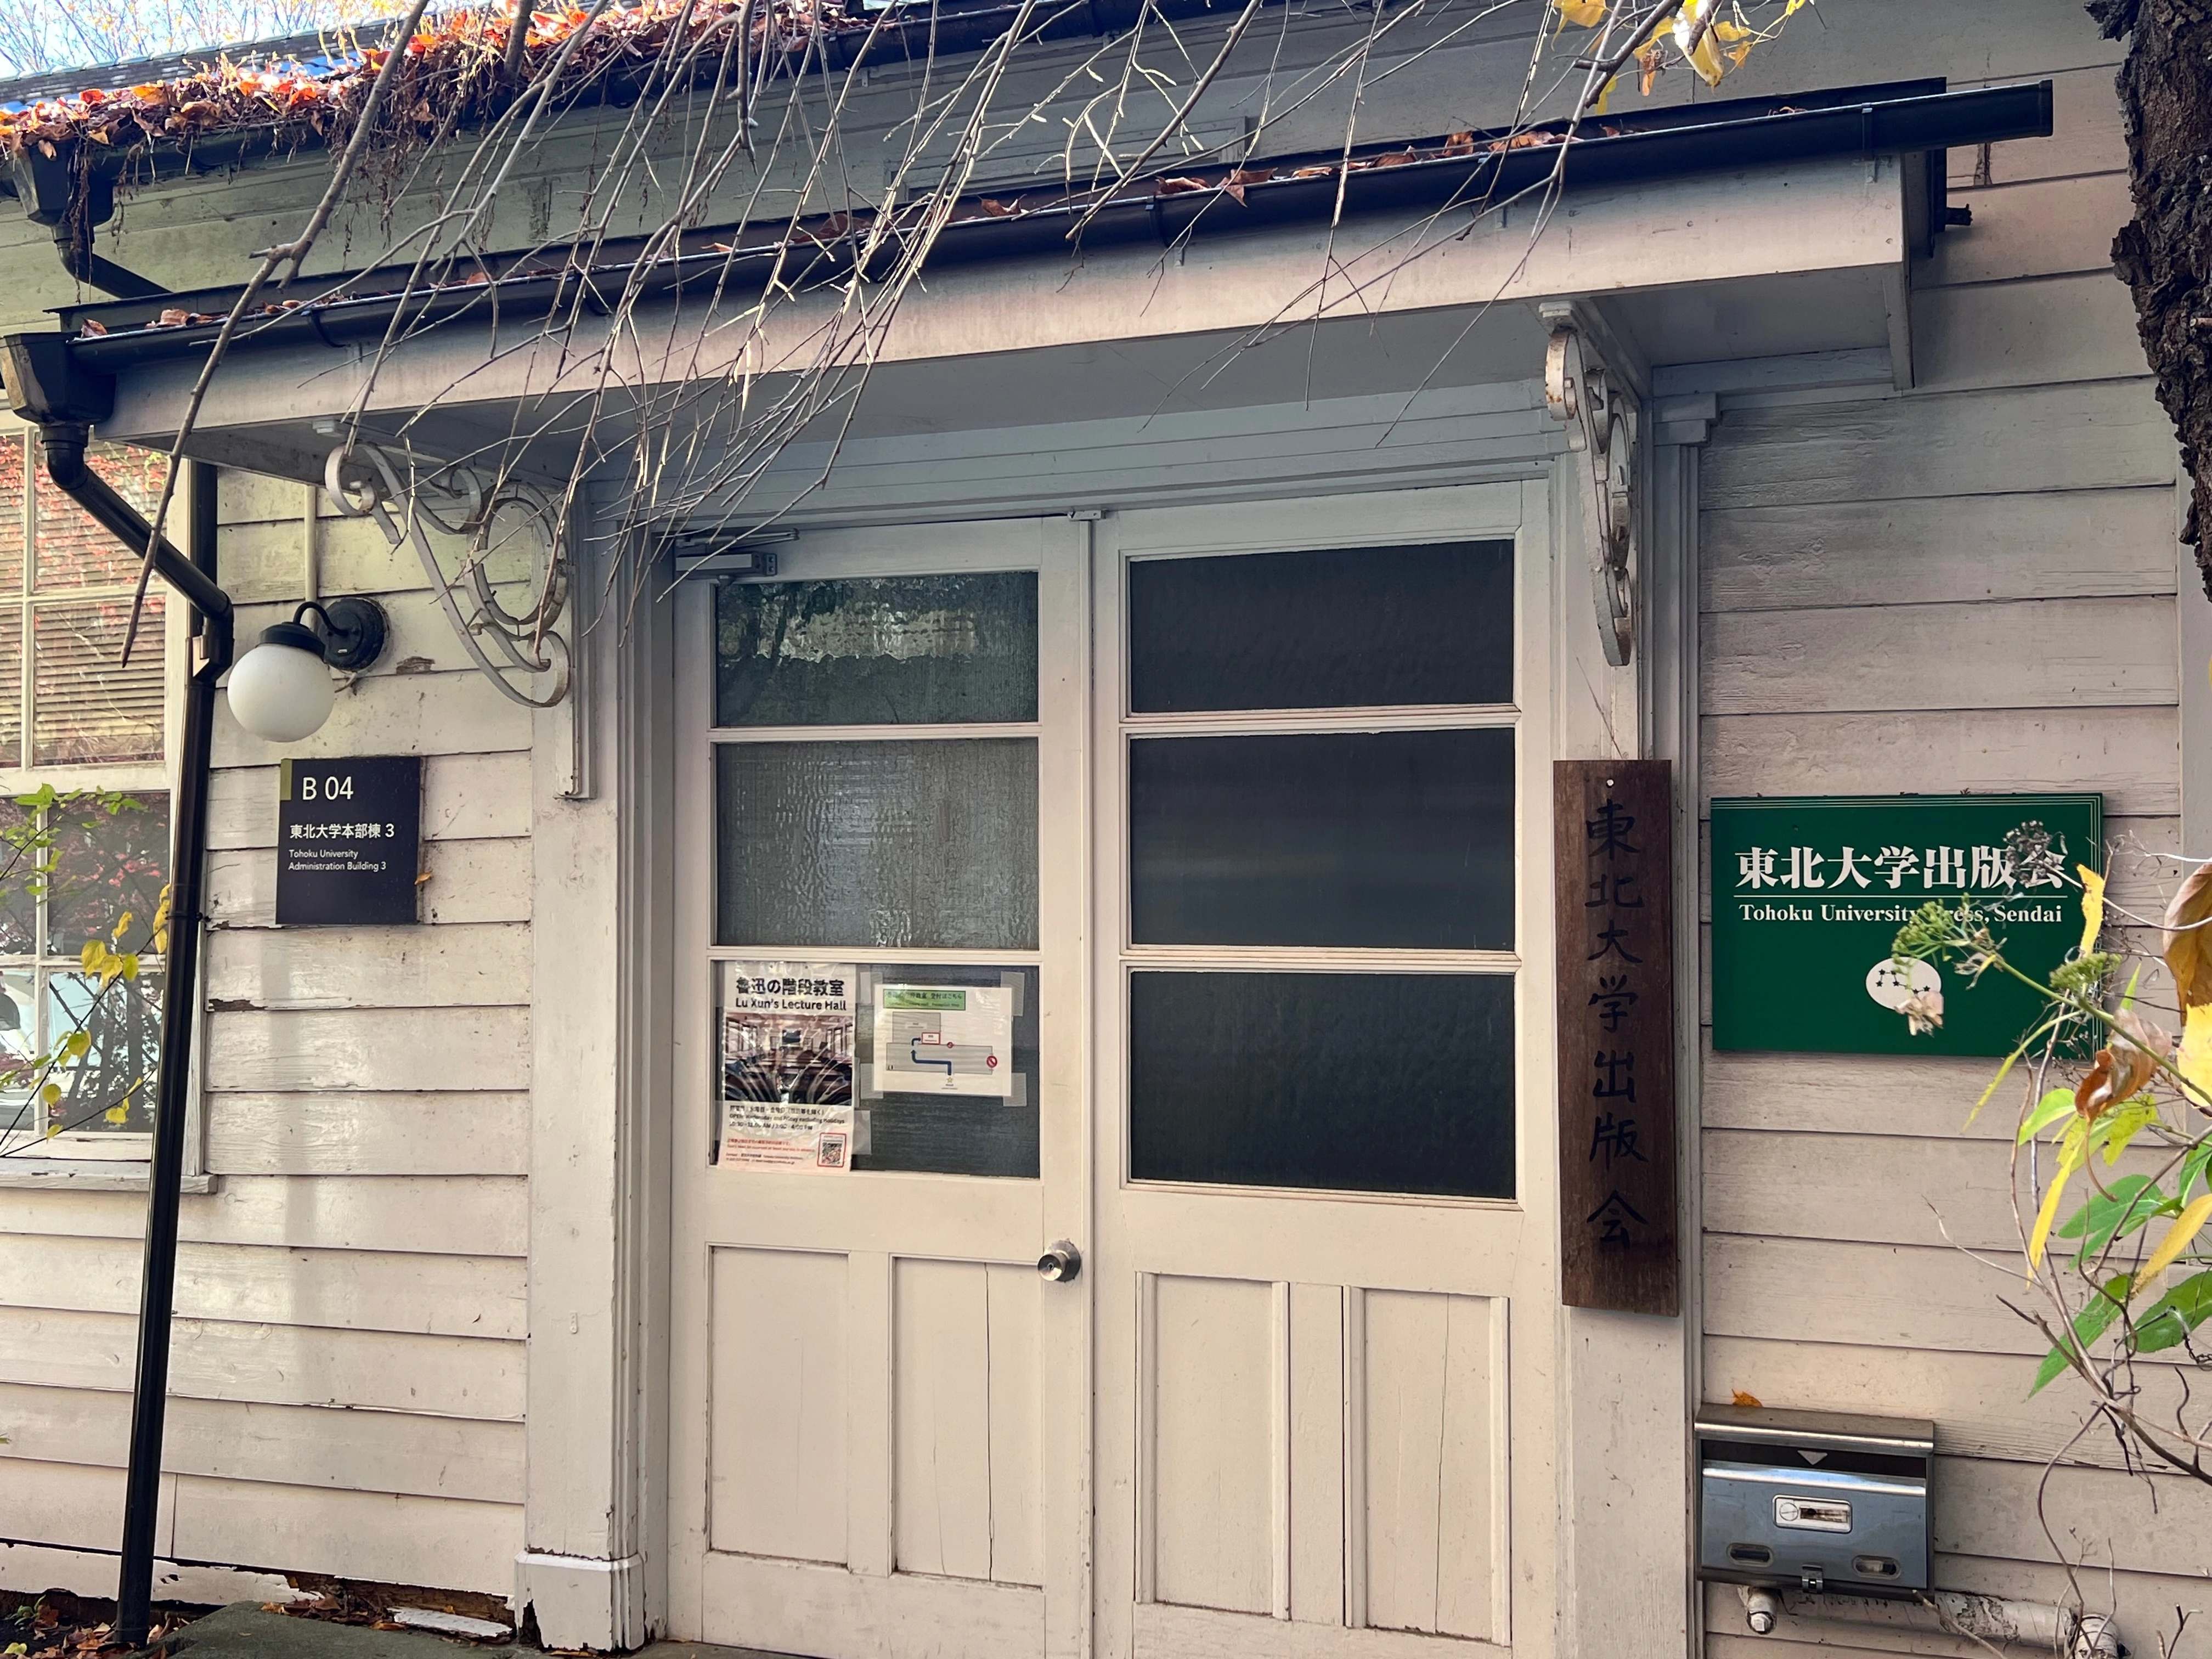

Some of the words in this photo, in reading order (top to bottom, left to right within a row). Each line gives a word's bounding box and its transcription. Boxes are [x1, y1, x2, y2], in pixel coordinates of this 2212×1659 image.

[302, 776, 317, 800] B
[325, 776, 354, 800] 04
[290, 823, 381, 839] 東北大学本部棟
[385, 823, 394, 838] 3
[289, 849, 318, 858] Tohoku
[320, 849, 358, 860] University
[288, 862, 345, 871] Administration
[347, 861, 379, 872] Building
[381, 861, 386, 870] 3
[1739, 904, 1813, 922] Tohoku
[1994, 904, 2062, 922] Sendai
[736, 977, 845, 996] 魯迅の階段教室
[736, 998, 748, 1008] Lu
[782, 1000, 822, 1010] Lecture
[825, 1000, 847, 1011] Hall
[1584, 797, 1648, 1250] 東北大学出版会
